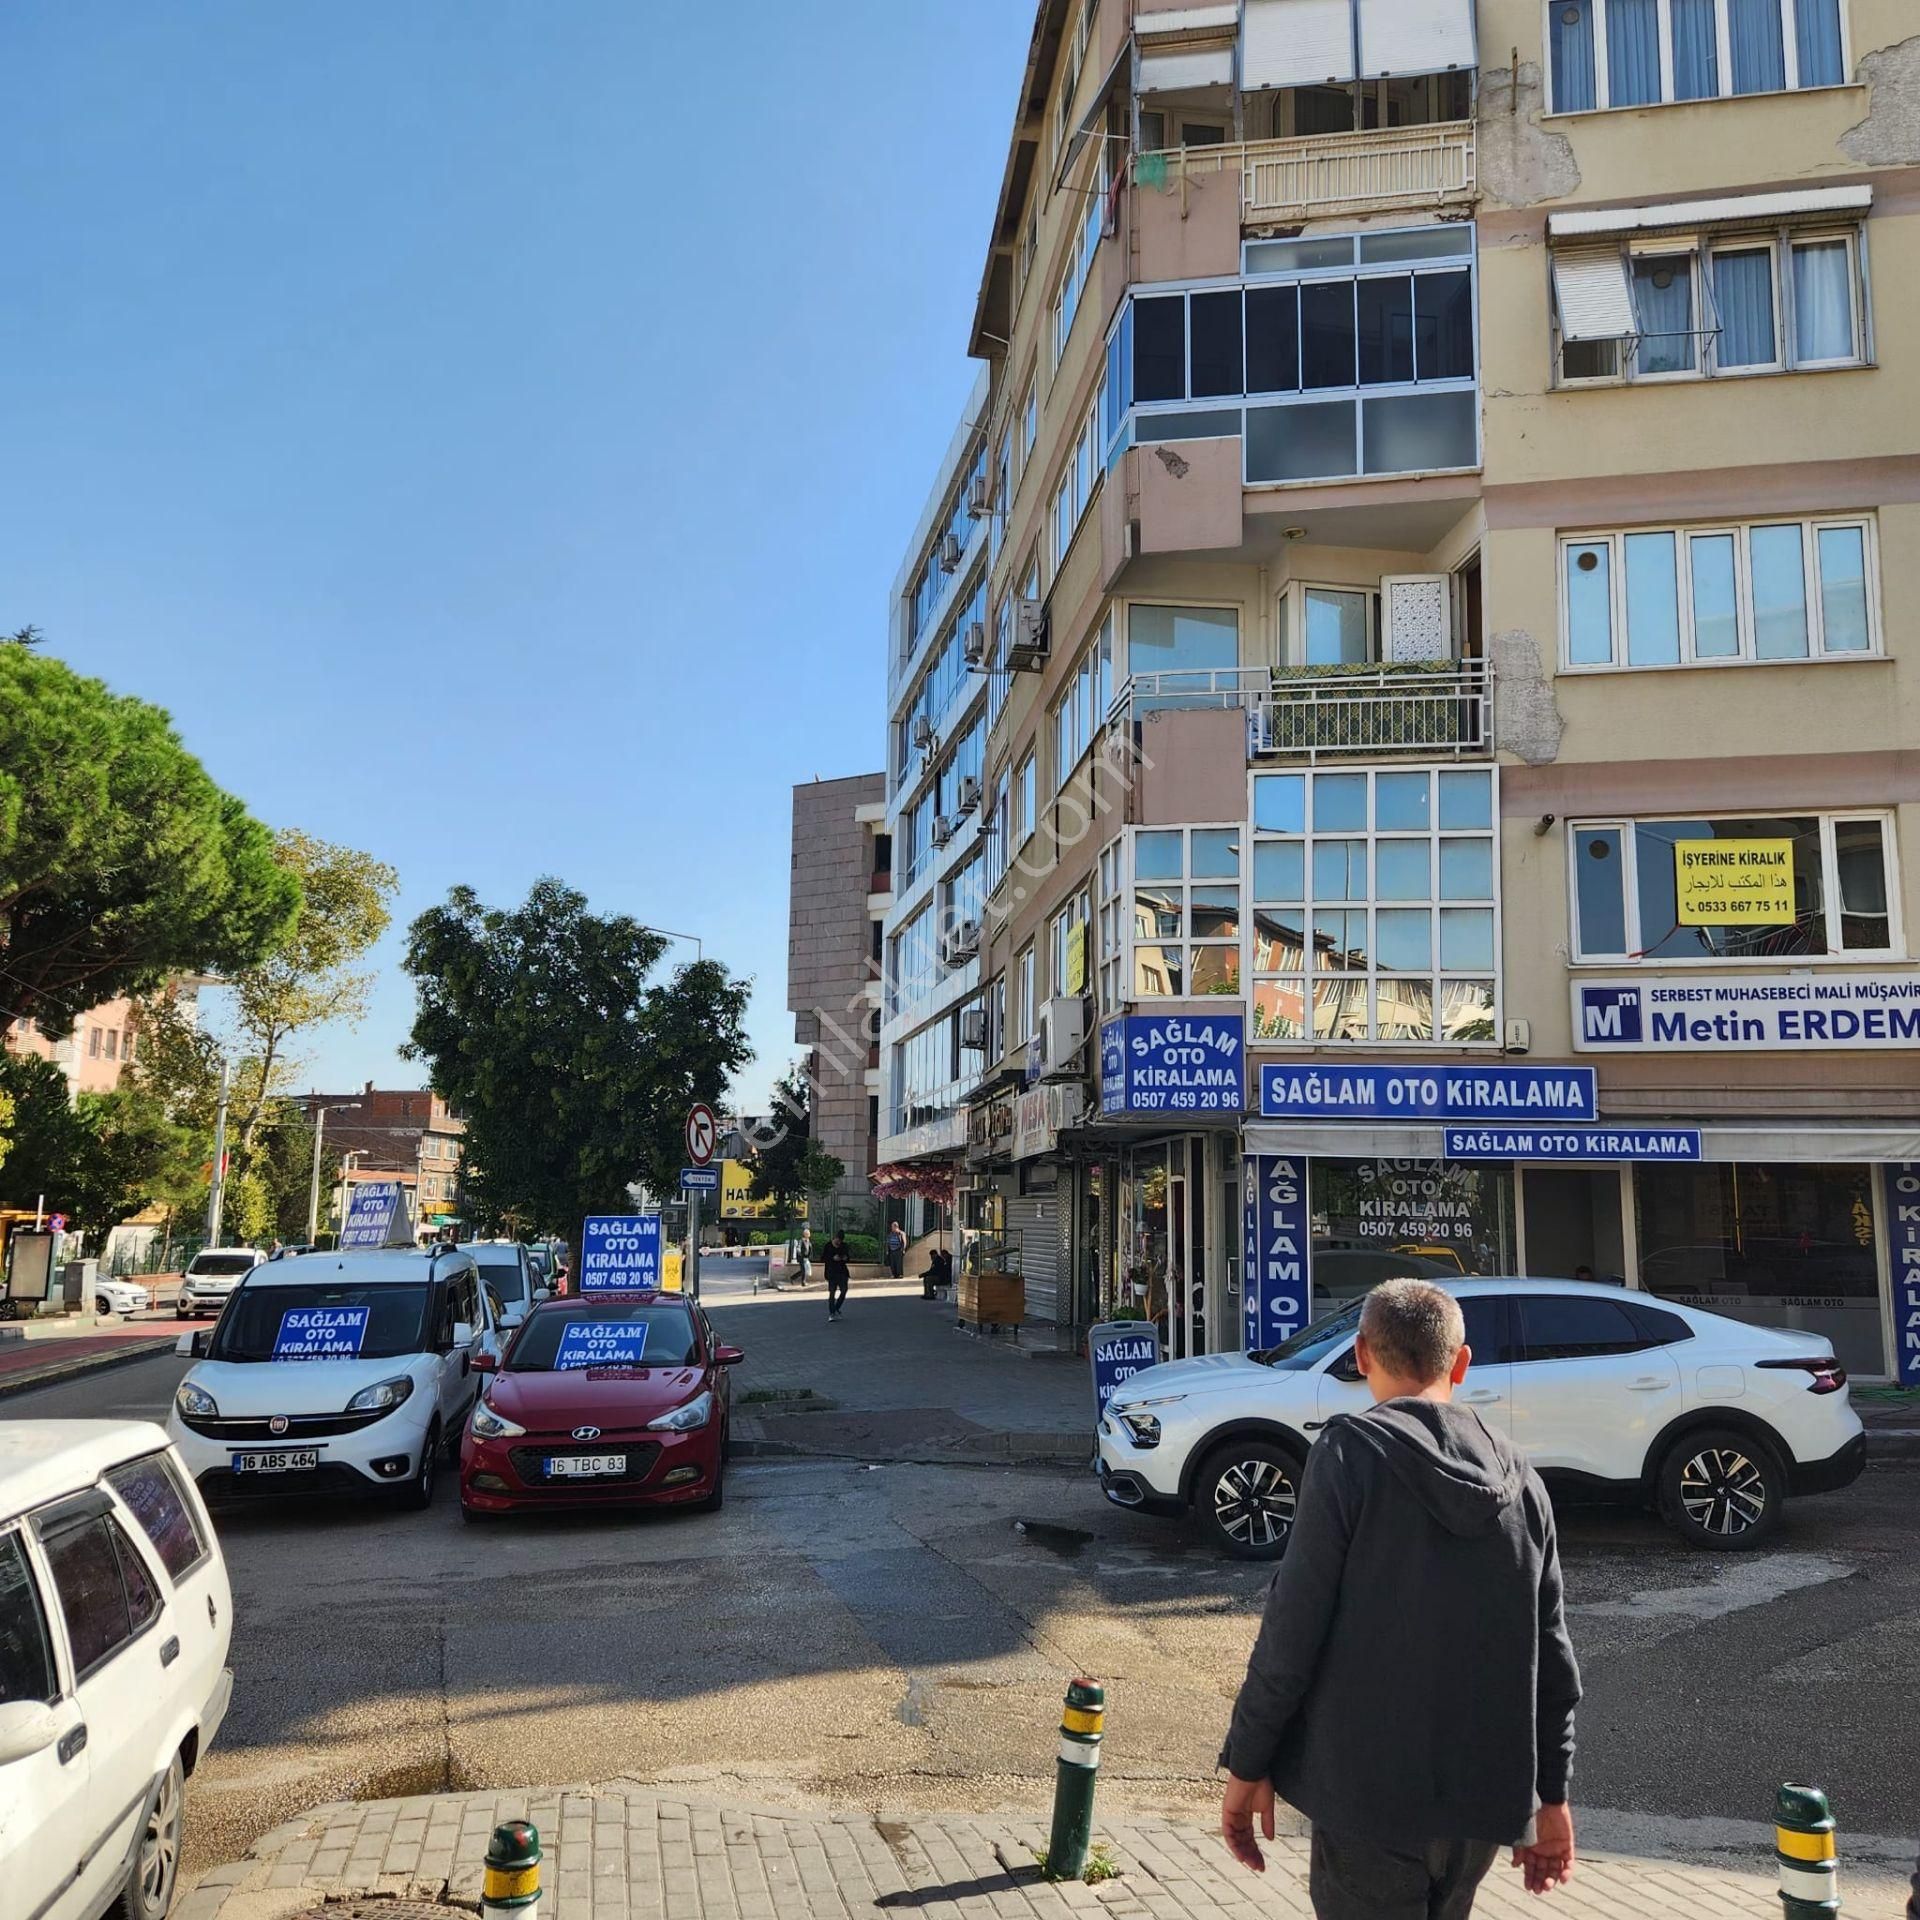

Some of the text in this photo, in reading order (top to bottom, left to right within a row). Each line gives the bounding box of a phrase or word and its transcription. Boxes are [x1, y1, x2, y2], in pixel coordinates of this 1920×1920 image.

[1682, 849, 1786, 868] İŞYERİNE KİRALIK
[1728, 873, 1765, 892] المكتب
[1770, 873, 1787, 888] هذا
[1698, 900, 1788, 912] 0533 667 75 11
[1651, 989, 1712, 1002] SERBEST
[1716, 983, 1810, 1001] MUHASEBECİ
[1815, 982, 1851, 999] MALİ
[1652, 1009, 1920, 1041] Metin ERDEM
[1131, 1019, 1238, 1057] SAĞLAM
[1163, 1048, 1206, 1065] OTO
[1133, 1065, 1237, 1086] KİRALAMA
[1271, 1072, 1375, 1104] SAĞLAM
[1387, 1078, 1438, 1105] OTO
[1133, 1092, 1166, 1108] 0507
[1170, 1092, 1196, 1108] 459
[1201, 1092, 1218, 1108] 20
[1222, 1092, 1239, 1108] 96
[1452, 1132, 1533, 1152] SAĞLAM
[1539, 1136, 1579, 1152] OTO
[1392, 1180, 1437, 1195] OTO
[363, 1199, 384, 1211] OTO
[588, 1221, 656, 1235] SAĞLAM
[1360, 1221, 1473, 1238] 0507 459 20 96
[605, 1238, 639, 1251] OTO
[585, 1272, 608, 1286] 0507
[609, 1272, 627, 1285] 459
[629, 1272, 640, 1285] 20
[642, 1271, 654, 1285] 96
[287, 1311, 363, 1328] SAĞLAM
[305, 1329, 336, 1340] OTO
[568, 1325, 642, 1338] SAĞLAM
[587, 1340, 617, 1349] OTO
[1097, 1340, 1153, 1362] SAĞLAM
[1115, 1366, 1137, 1381] OTO
[242, 1453, 315, 1469] 16 ABS 464
[552, 1457, 624, 1473] 16 TBC 83
